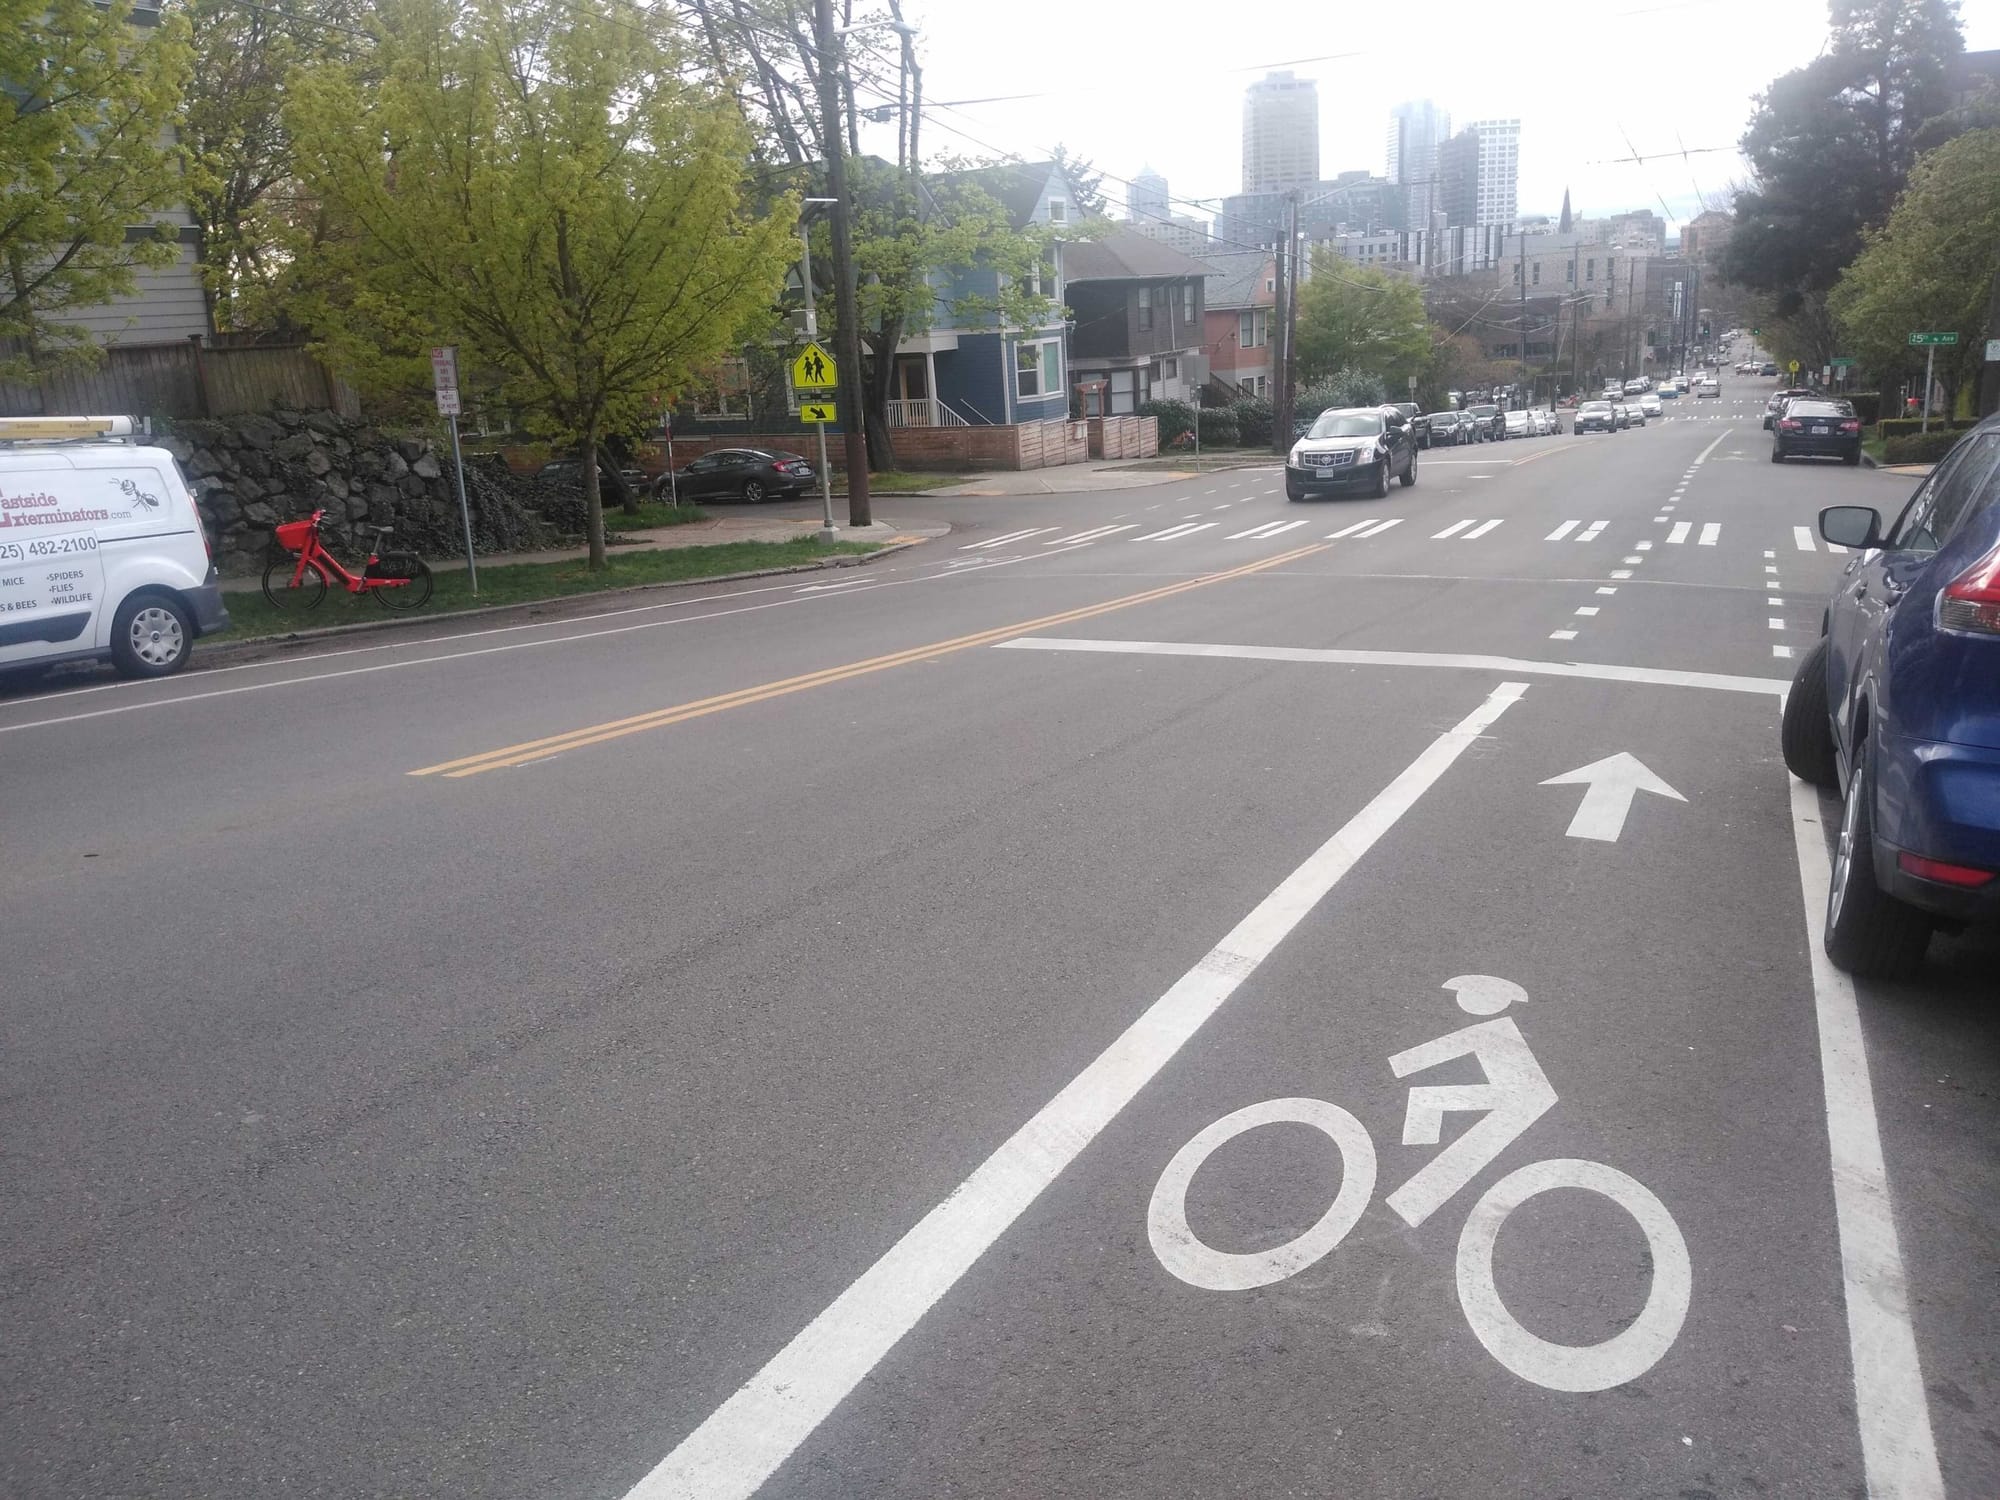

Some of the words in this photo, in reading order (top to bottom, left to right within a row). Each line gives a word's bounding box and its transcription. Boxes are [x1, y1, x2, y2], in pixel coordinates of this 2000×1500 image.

[0, 488, 58, 510] astside
[29, 536, 97, 556] 482-2100
[2, 577, 25, 587] MICE
[49, 569, 84, 582] SPIDERS
[51, 583, 74, 593] FLIES
[15, 599, 38, 610] BEES
[53, 592, 93, 605] WILDLIFE
